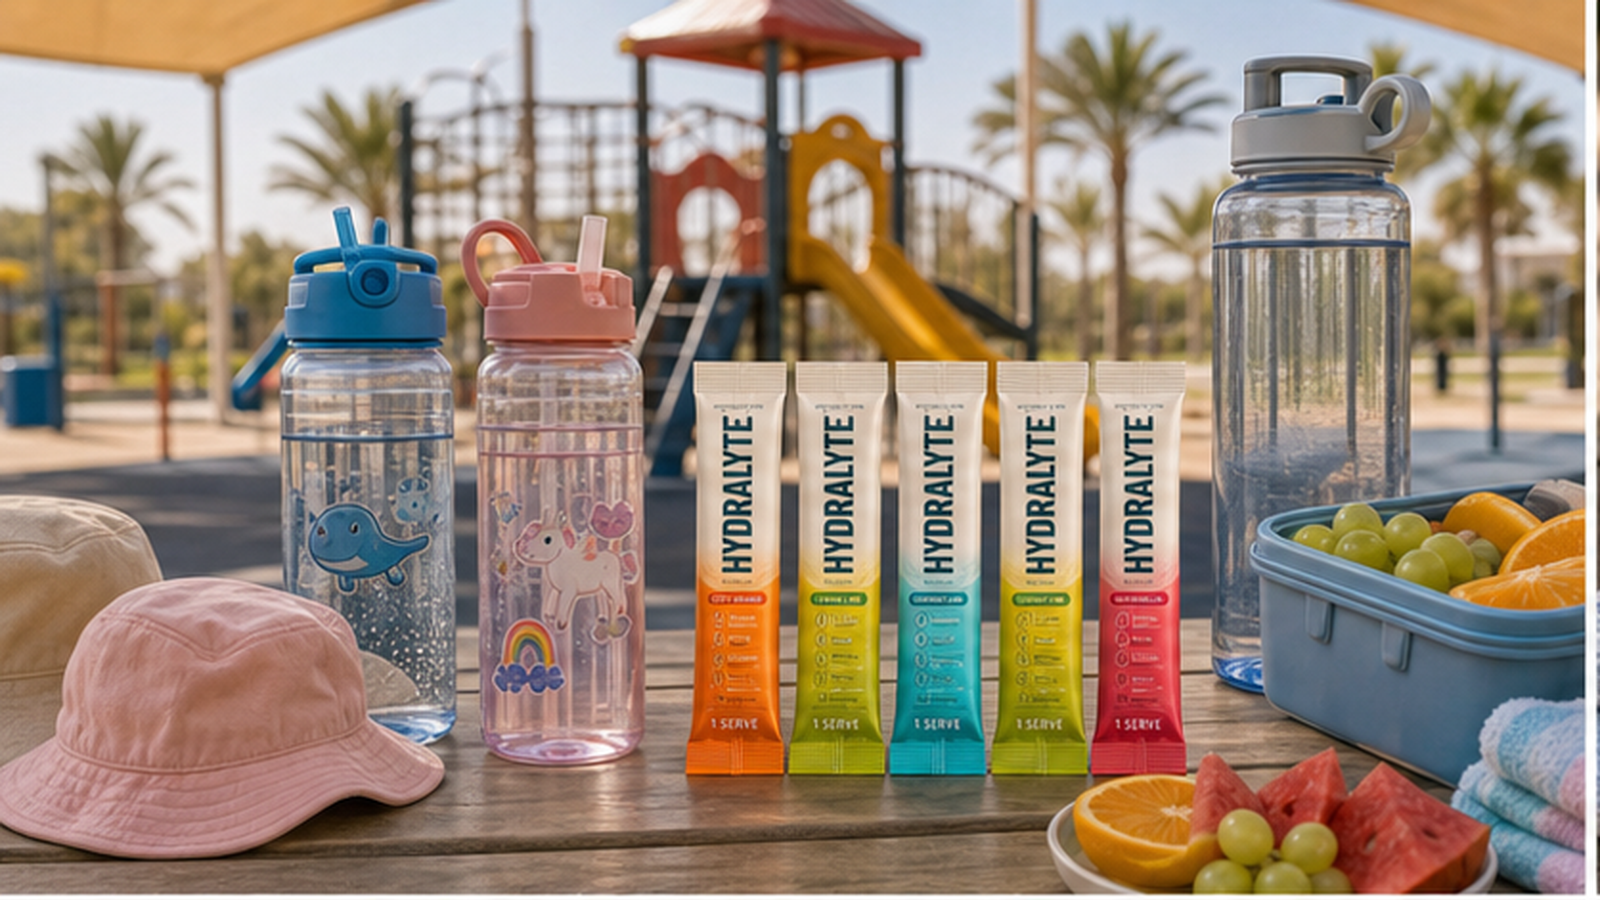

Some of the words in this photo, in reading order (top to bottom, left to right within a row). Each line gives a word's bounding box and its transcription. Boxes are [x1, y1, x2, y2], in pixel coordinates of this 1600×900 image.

[721, 415, 753, 574] HYDRALYTE
[823, 415, 855, 574] HYDRALYTE
[923, 415, 954, 574] HYDRALYTE
[1025, 415, 1056, 575] HYDRALYTE
[1123, 415, 1154, 574] HYDRALYTE
[711, 718, 717, 730] 1
[720, 717, 759, 730] SERVE
[813, 718, 819, 730] 1
[821, 717, 859, 731] SERVE
[914, 718, 920, 730] 1
[923, 717, 960, 730] SERVE
[1016, 718, 1022, 730] 1
[1025, 718, 1063, 731] SERVE
[1115, 718, 1121, 731] 1
[1124, 718, 1161, 731] SERVE
